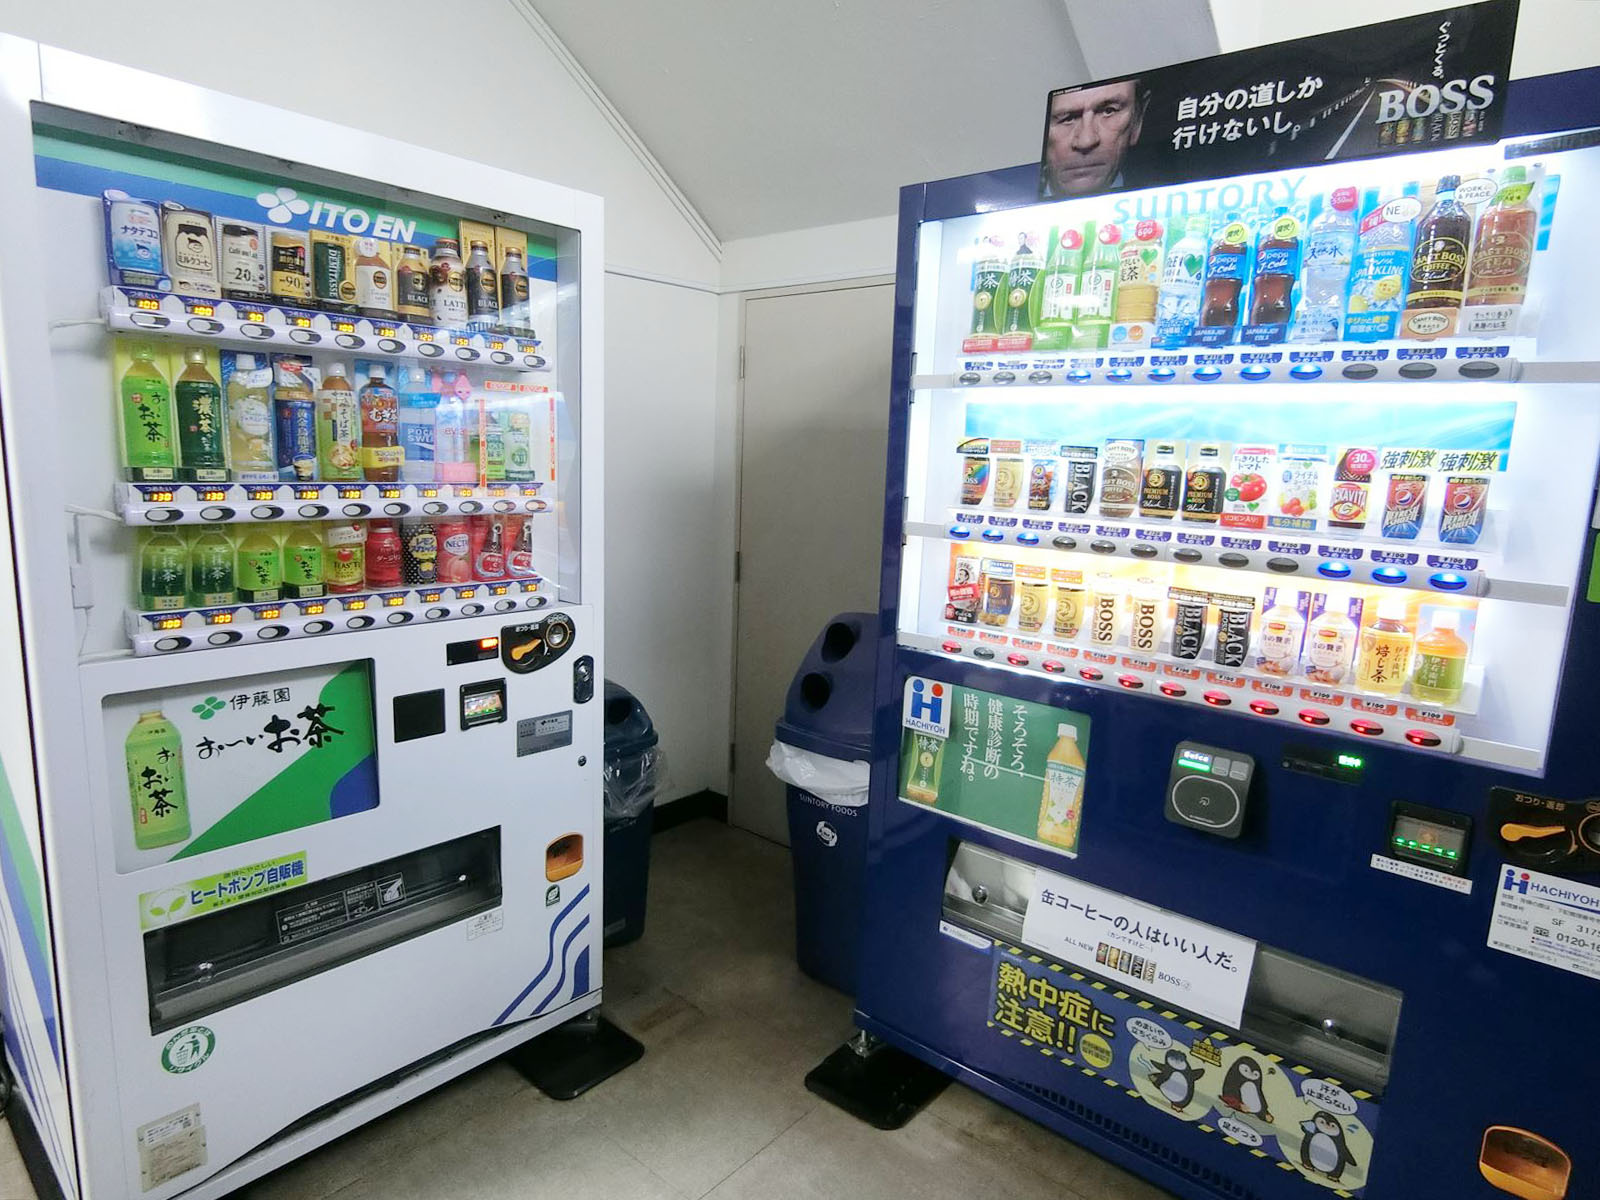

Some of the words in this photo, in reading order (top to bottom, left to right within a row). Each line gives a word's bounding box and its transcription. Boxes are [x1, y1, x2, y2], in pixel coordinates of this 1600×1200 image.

[1177, 76, 1323, 121] 自分の道しか
[1375, 74, 1495, 124] BOSS
[1172, 112, 1301, 150] 行けないし。
[309, 201, 370, 234] ITO
[373, 215, 416, 243] EN
[121, 225, 158, 239] ナタデココ
[138, 300, 158, 310] 100
[193, 307, 213, 316] 100
[249, 314, 263, 322] 90
[137, 403, 167, 443] お茶
[1380, 449, 1437, 469] 強刺激
[1439, 451, 1498, 472] 強刺激
[303, 491, 318, 499] 130
[346, 490, 360, 498] 130
[386, 490, 400, 498] 130
[1071, 462, 1090, 513] BLACK
[152, 493, 172, 501] 130
[207, 492, 224, 500] 130
[256, 492, 272, 500] 130
[308, 605, 324, 614] 100
[351, 602, 365, 610] 100
[389, 598, 403, 606] 100
[214, 615, 231, 623] 100
[263, 610, 280, 618] 100
[1098, 598, 1114, 642] BOSS
[162, 620, 182, 629] 100
[1138, 604, 1154, 649] BOSS
[1180, 606, 1199, 657] BLACK
[1225, 611, 1247, 667] BLACK
[229, 687, 290, 711] 伊藤園
[1366, 701, 1384, 709] ¥100
[1422, 711, 1441, 719] ¥100
[905, 718, 946, 734] HACHIYOH
[918, 736, 941, 752] 特茶
[960, 693, 979, 782] 時期ですね。
[984, 698, 1003, 780] 健康診断の
[141, 766, 178, 817] お茶
[831, 804, 858, 817] FOODS
[1552, 917, 1566, 927] SF
[1041, 889, 1237, 973] 缶コーヒーの人はいい人だ。
[1064, 936, 1077, 946] ALL
[1078, 941, 1094, 952] NEW
[1158, 971, 1181, 987] BOSS
[998, 962, 1116, 1038] 熱中症に
[1319, 1084, 1341, 1097] 汗が
[1305, 1087, 1352, 1112] 止まらない
[1222, 1120, 1258, 1143] 足がつる
